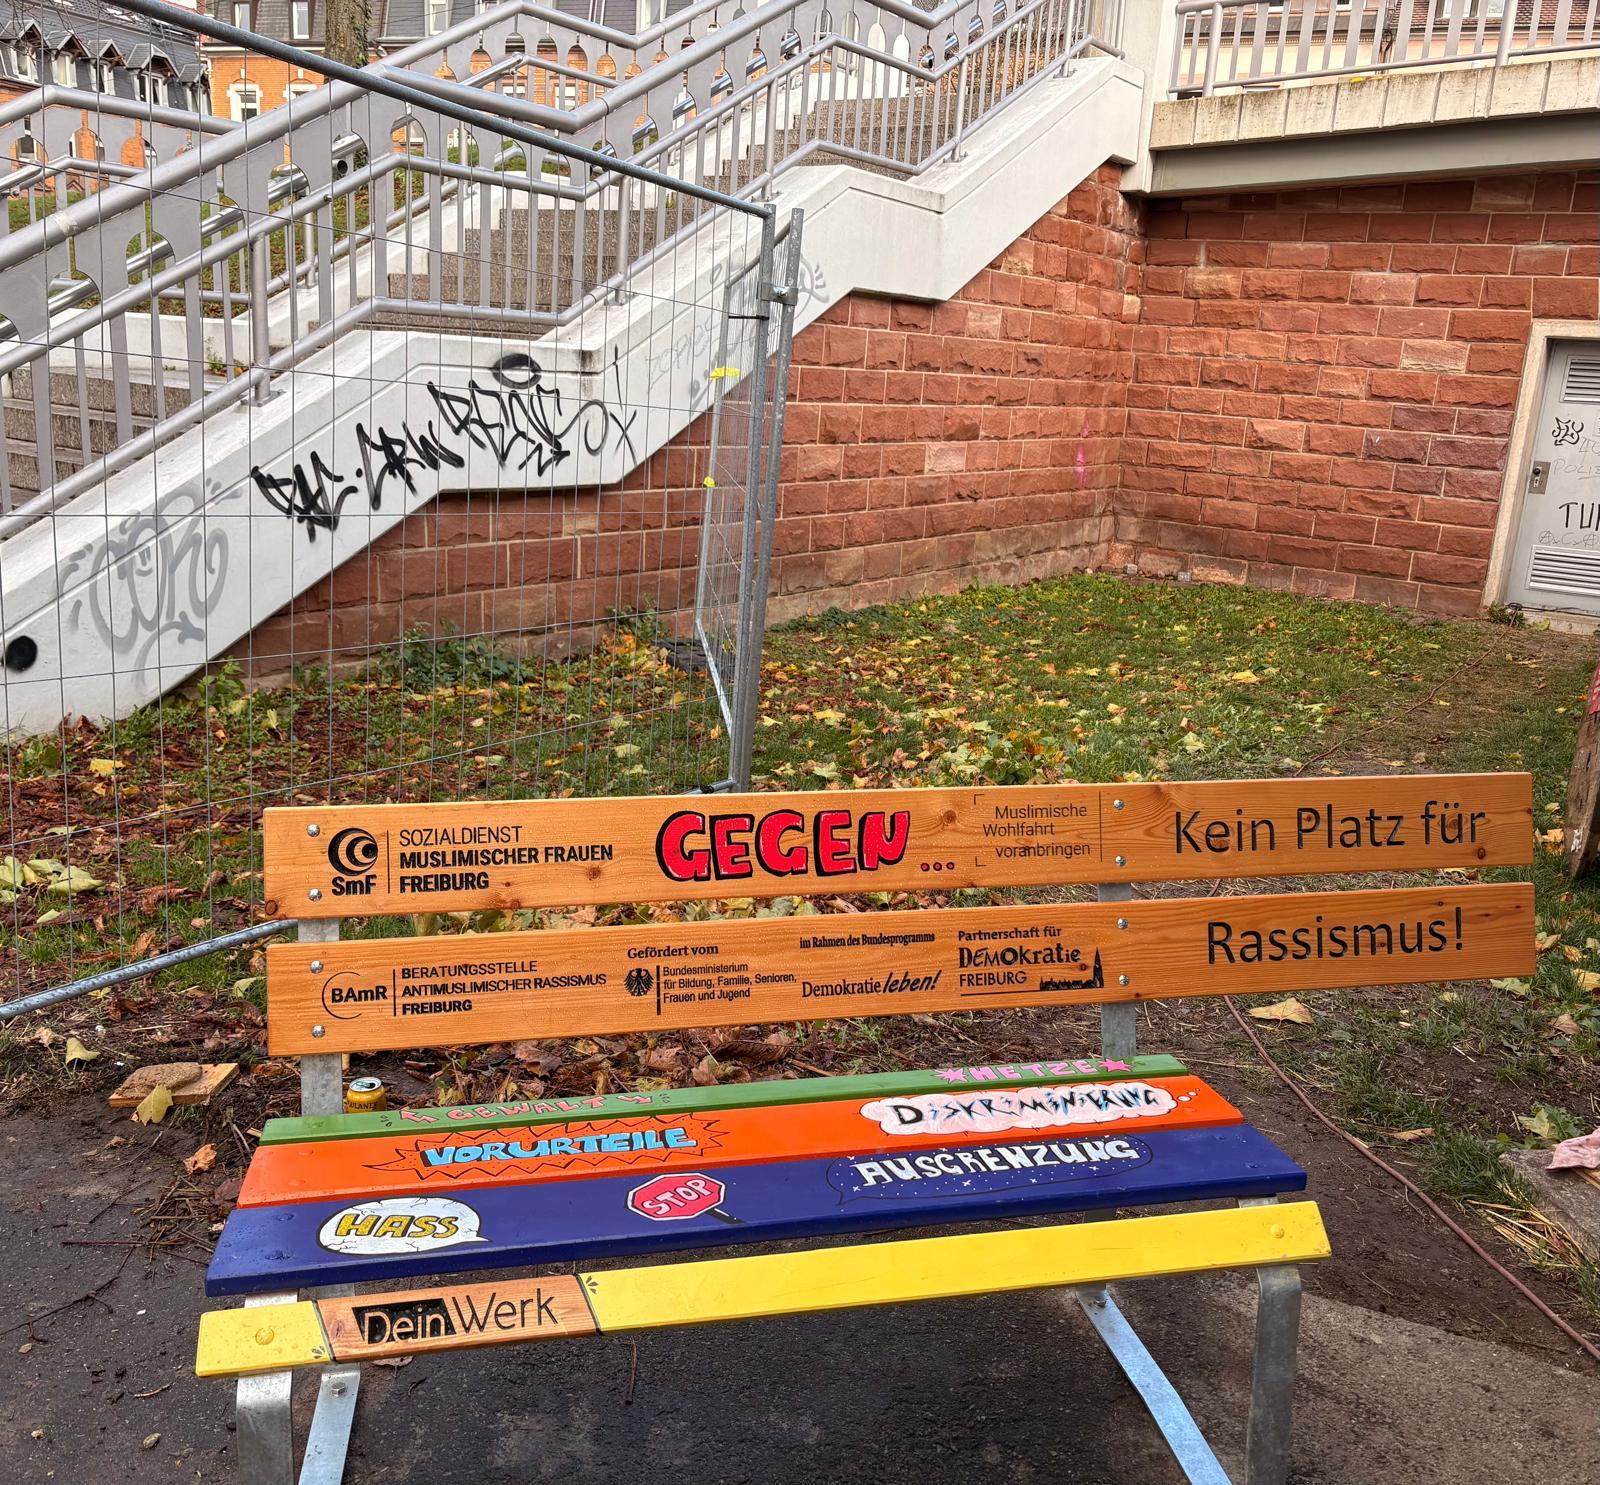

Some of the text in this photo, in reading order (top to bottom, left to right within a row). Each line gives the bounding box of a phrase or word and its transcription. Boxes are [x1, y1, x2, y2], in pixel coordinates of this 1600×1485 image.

[994, 802, 1088, 820] Muslimische
[399, 825, 523, 847] SOZIALDIENST
[982, 820, 1056, 839] Wohlfahrt
[1174, 799, 1486, 855] Kein Platz für
[655, 809, 910, 882] GEGEN
[995, 841, 1091, 859] voranbringen
[399, 844, 613, 869] MUSLIMISCHER FRAUEN
[331, 875, 377, 896] SmF
[399, 871, 490, 894] FREIBURG
[800, 932, 936, 949] im Rahmen des Bundesprogramms
[958, 926, 1062, 942] Partnerschaft für
[1207, 906, 1464, 965] Rassismus!
[627, 944, 719, 959] Gefördert vom
[401, 960, 538, 980] BERATUNGSSTELLE
[663, 961, 749, 977] Bundesministerium
[959, 970, 1028, 988] FREIBURG
[401, 973, 607, 998] ANTIMUSLIMISCHER RASSISMUS
[663, 973, 797, 990] für Bildung, Familie, Senioren,
[801, 969, 943, 998] Demokratie leben!
[330, 985, 388, 1004] BAmR
[663, 988, 751, 1004] Frauen und Jugend
[402, 999, 473, 1016] FREIBURG
[966, 1059, 1099, 1082] HETZE
[445, 1095, 608, 1121] GEWALT
[419, 1127, 698, 1168] VORURTEILE
[852, 1138, 1142, 1187] AUSGRENZUNG
[641, 1178, 714, 1216] STOP
[336, 1213, 460, 1240] HASS
